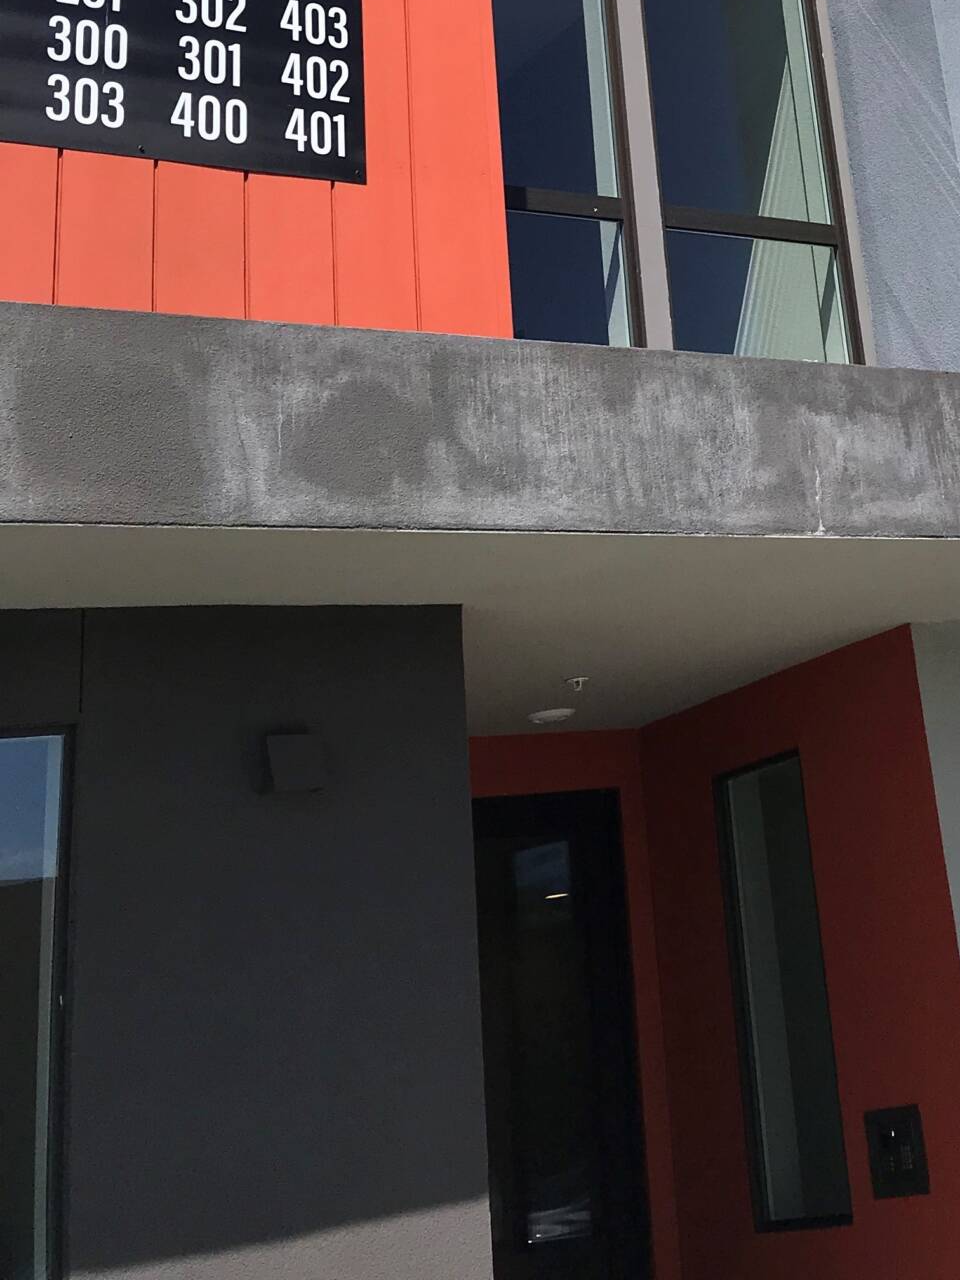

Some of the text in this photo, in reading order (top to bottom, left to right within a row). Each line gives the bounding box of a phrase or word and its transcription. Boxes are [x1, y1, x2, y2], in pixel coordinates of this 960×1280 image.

[46, 14, 351, 104] 300 301 402
[45, 73, 346, 158] 303 400 401
